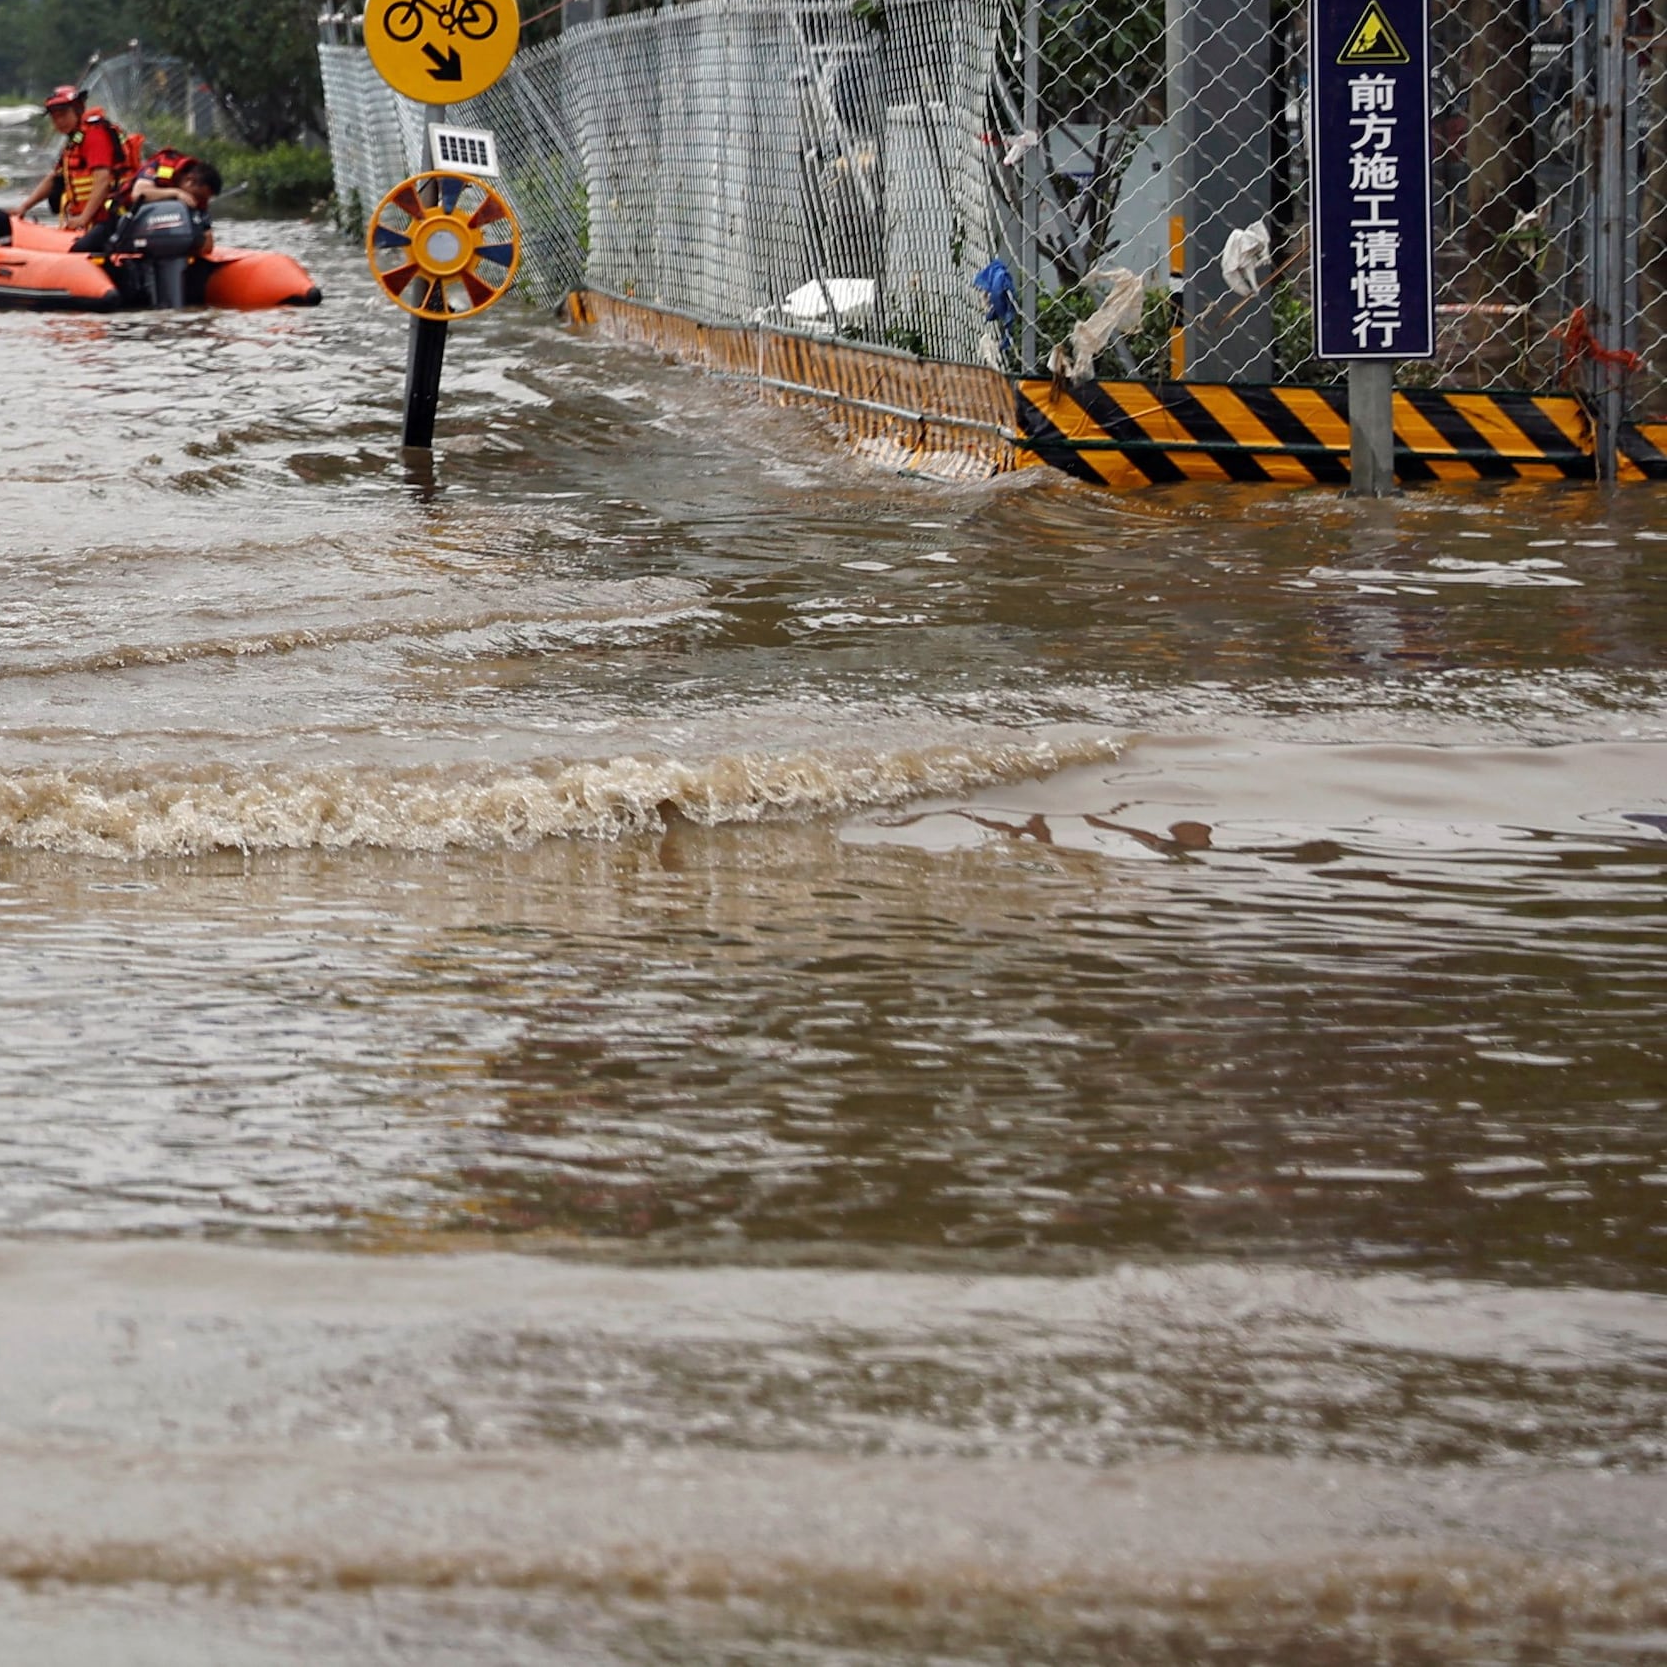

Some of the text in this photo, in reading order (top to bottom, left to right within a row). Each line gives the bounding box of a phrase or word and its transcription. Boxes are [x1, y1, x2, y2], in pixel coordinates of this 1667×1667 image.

[1347, 72, 1402, 350] 前方施工请慢行
